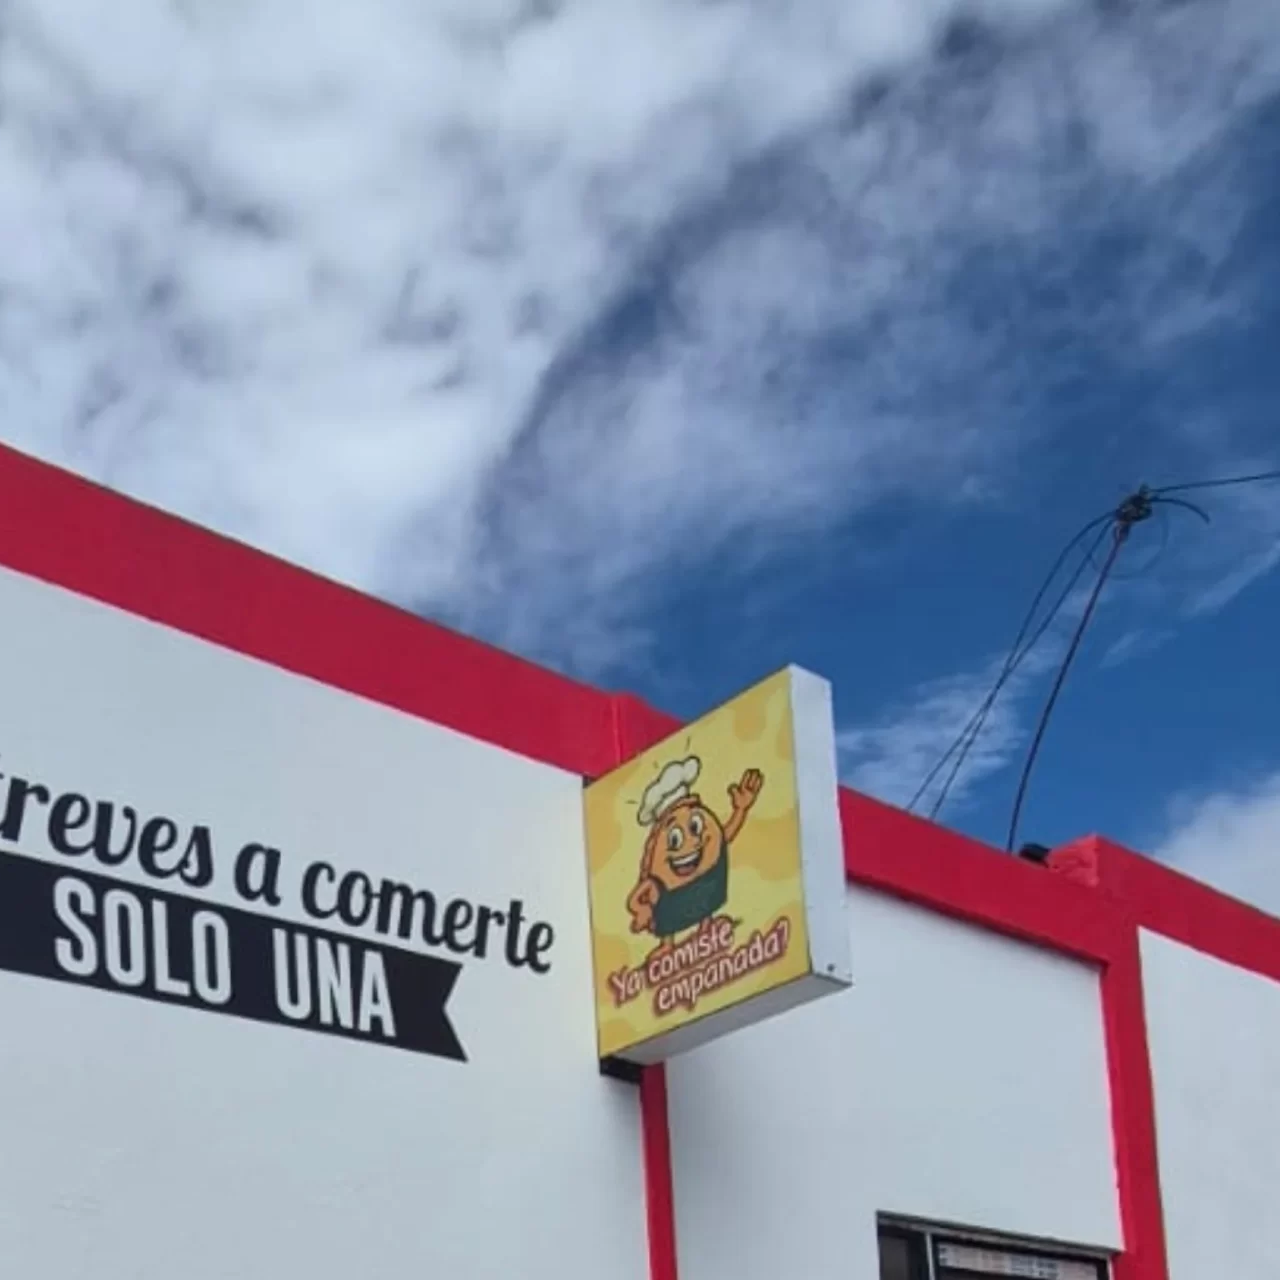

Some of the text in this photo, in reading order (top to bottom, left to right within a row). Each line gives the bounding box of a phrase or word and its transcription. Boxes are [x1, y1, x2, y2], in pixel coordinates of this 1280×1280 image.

[53, 876, 397, 1039] SOLO UNA
[233, 840, 282, 906] a
[300, 859, 556, 975] comerte
[610, 920, 734, 1002] Ya comiste
